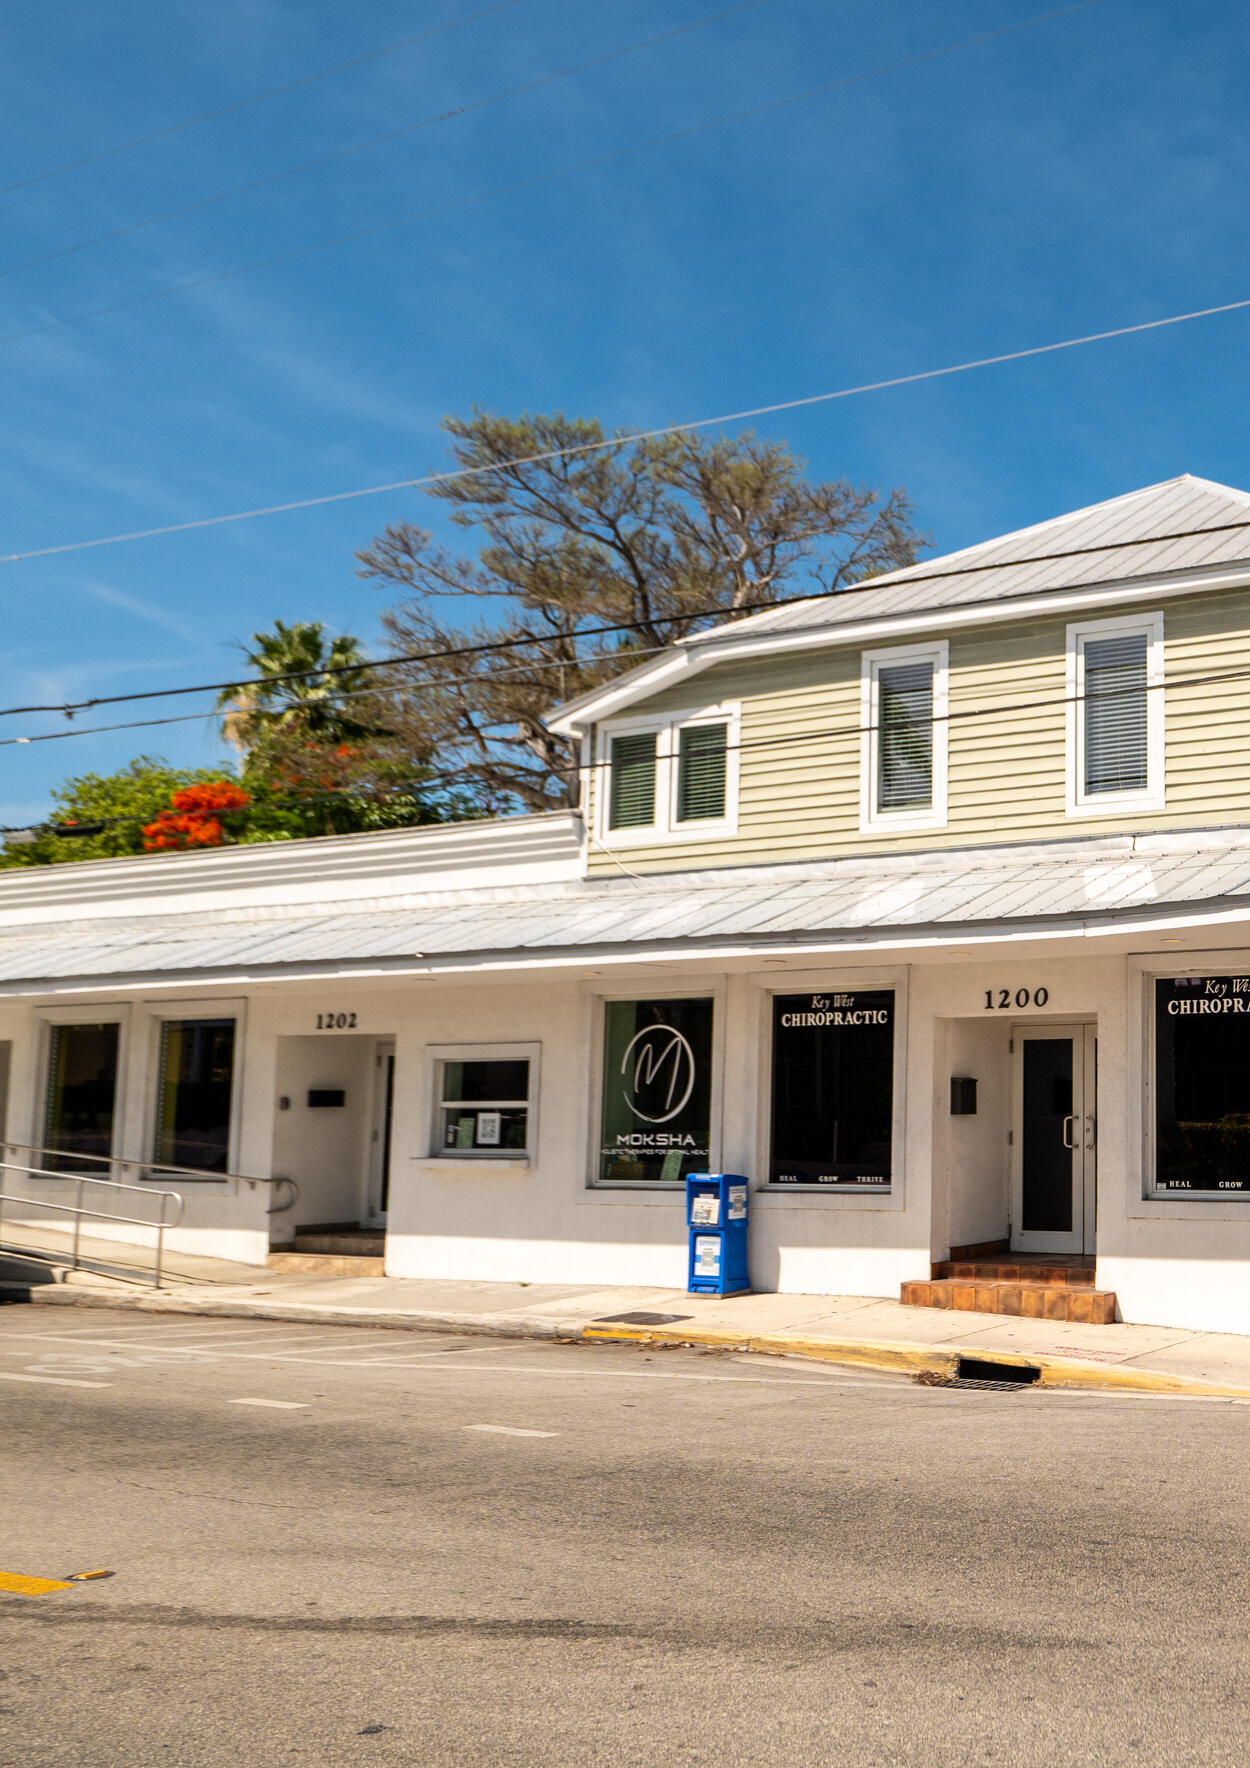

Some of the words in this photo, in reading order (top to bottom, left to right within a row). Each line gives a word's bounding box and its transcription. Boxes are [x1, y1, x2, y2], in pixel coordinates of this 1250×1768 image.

[1205, 980, 1227, 998] Key
[811, 996, 830, 1011] Key
[833, 995, 854, 1007] West
[984, 987, 1049, 1009] 1200
[315, 1012, 358, 1030] 1202
[781, 1010, 888, 1027] CHIROPRACTIC
[616, 1133, 696, 1146] MOKSHA
[1169, 1180, 1192, 1188] HEAL
[1218, 1181, 1243, 1189] GROW
